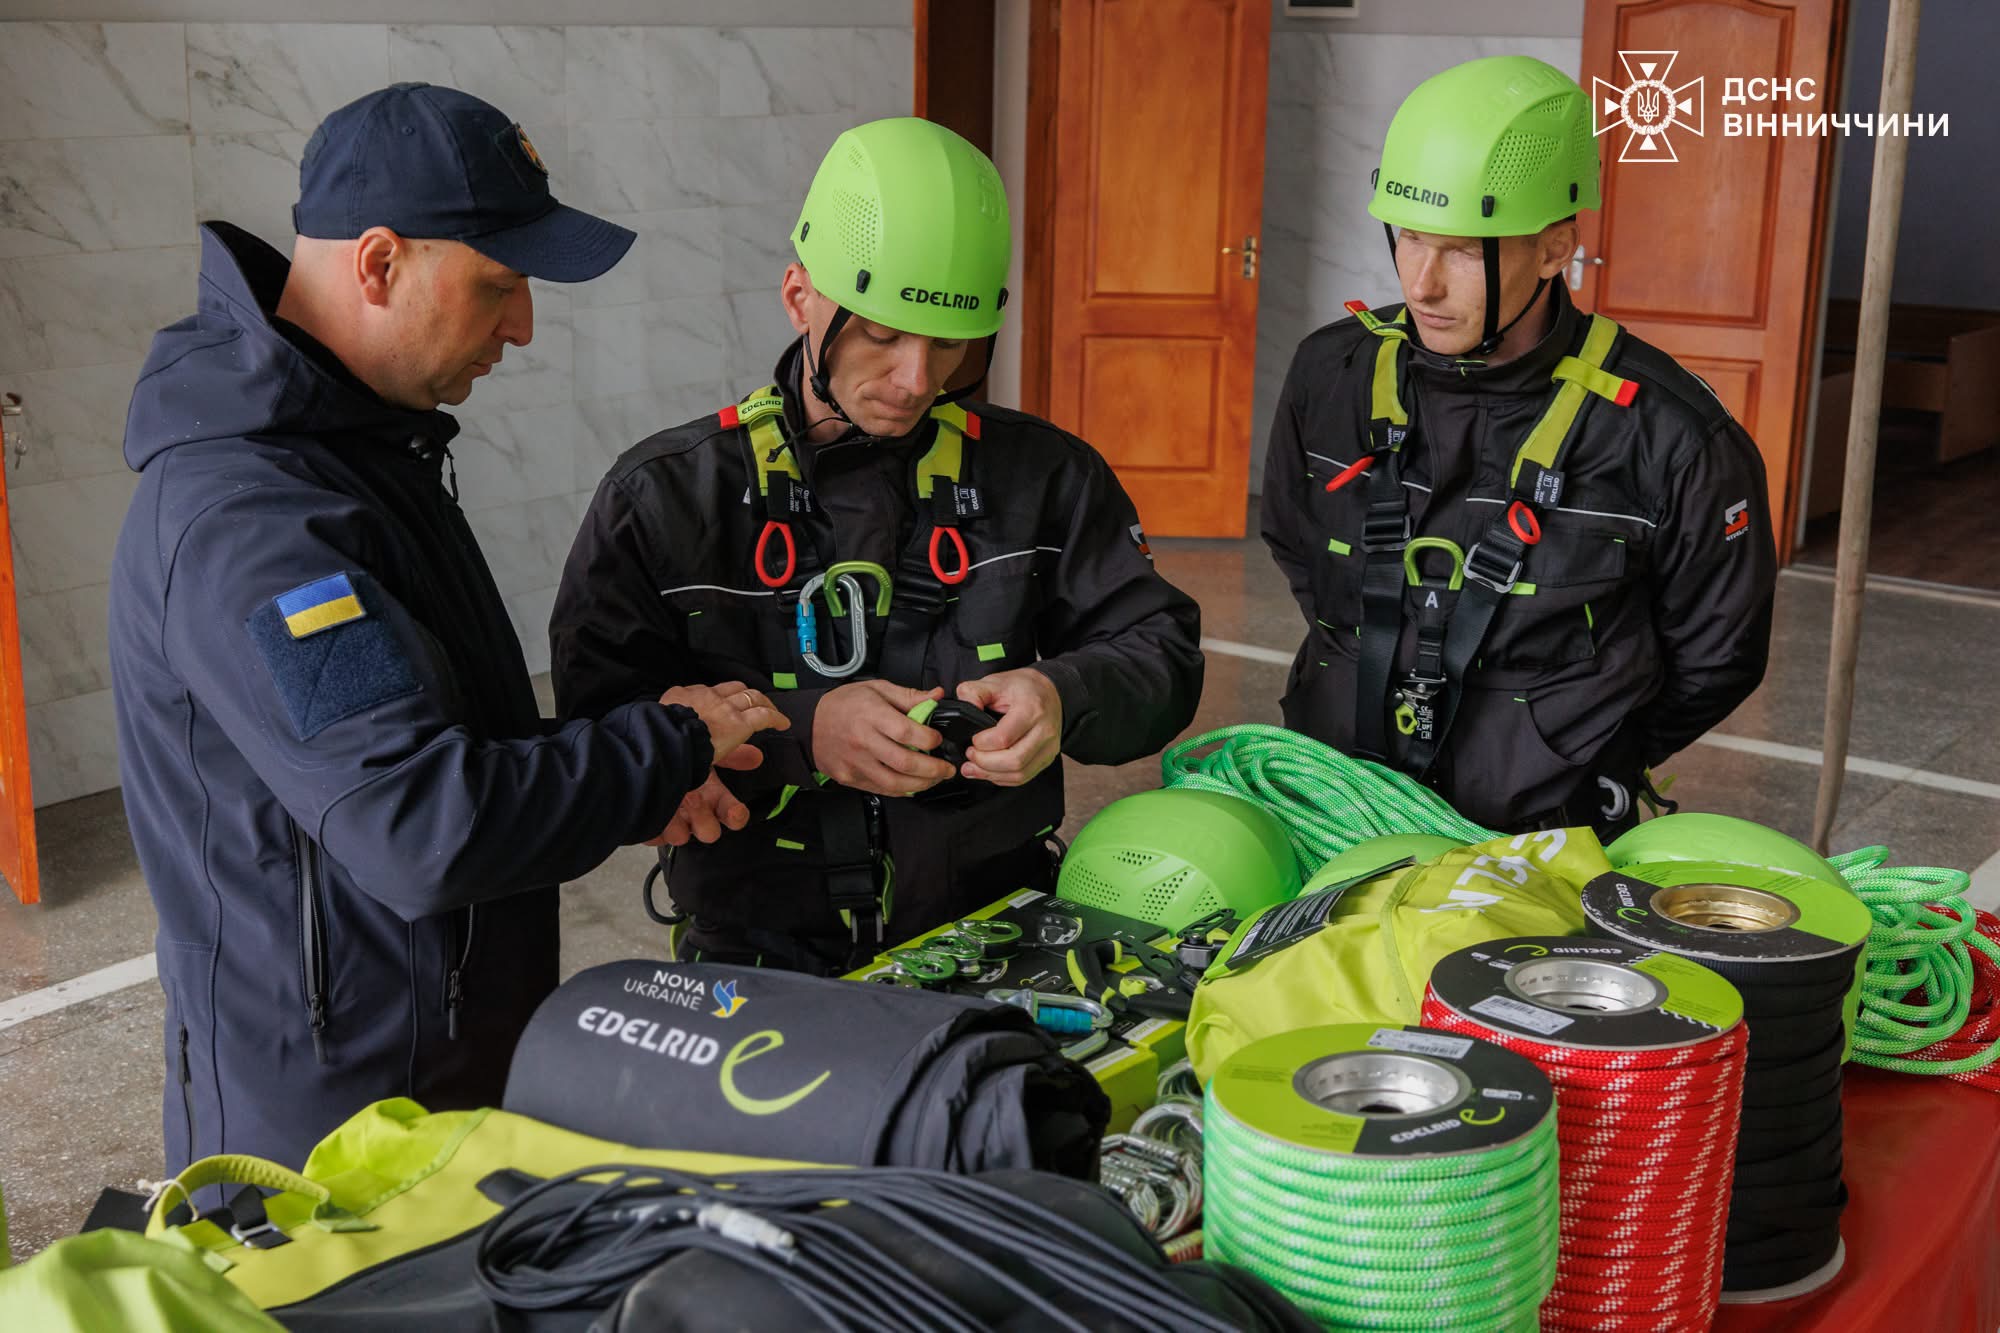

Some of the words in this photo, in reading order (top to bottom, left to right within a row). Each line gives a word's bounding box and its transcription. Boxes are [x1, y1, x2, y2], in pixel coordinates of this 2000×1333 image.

[1385, 181, 1449, 207] EDELRID
[900, 287, 980, 310] EDELRID
[742, 400, 781, 414] EDELRID
[1424, 591, 1439, 609] A
[1615, 883, 1635, 907] EDELRID
[1552, 947, 1623, 955] EDELRID
[624, 977, 702, 1011] UKRAINE
[653, 969, 706, 996] NOVA
[577, 1006, 720, 1066] EDELRID
[1390, 1119, 1462, 1143] EDELRID
